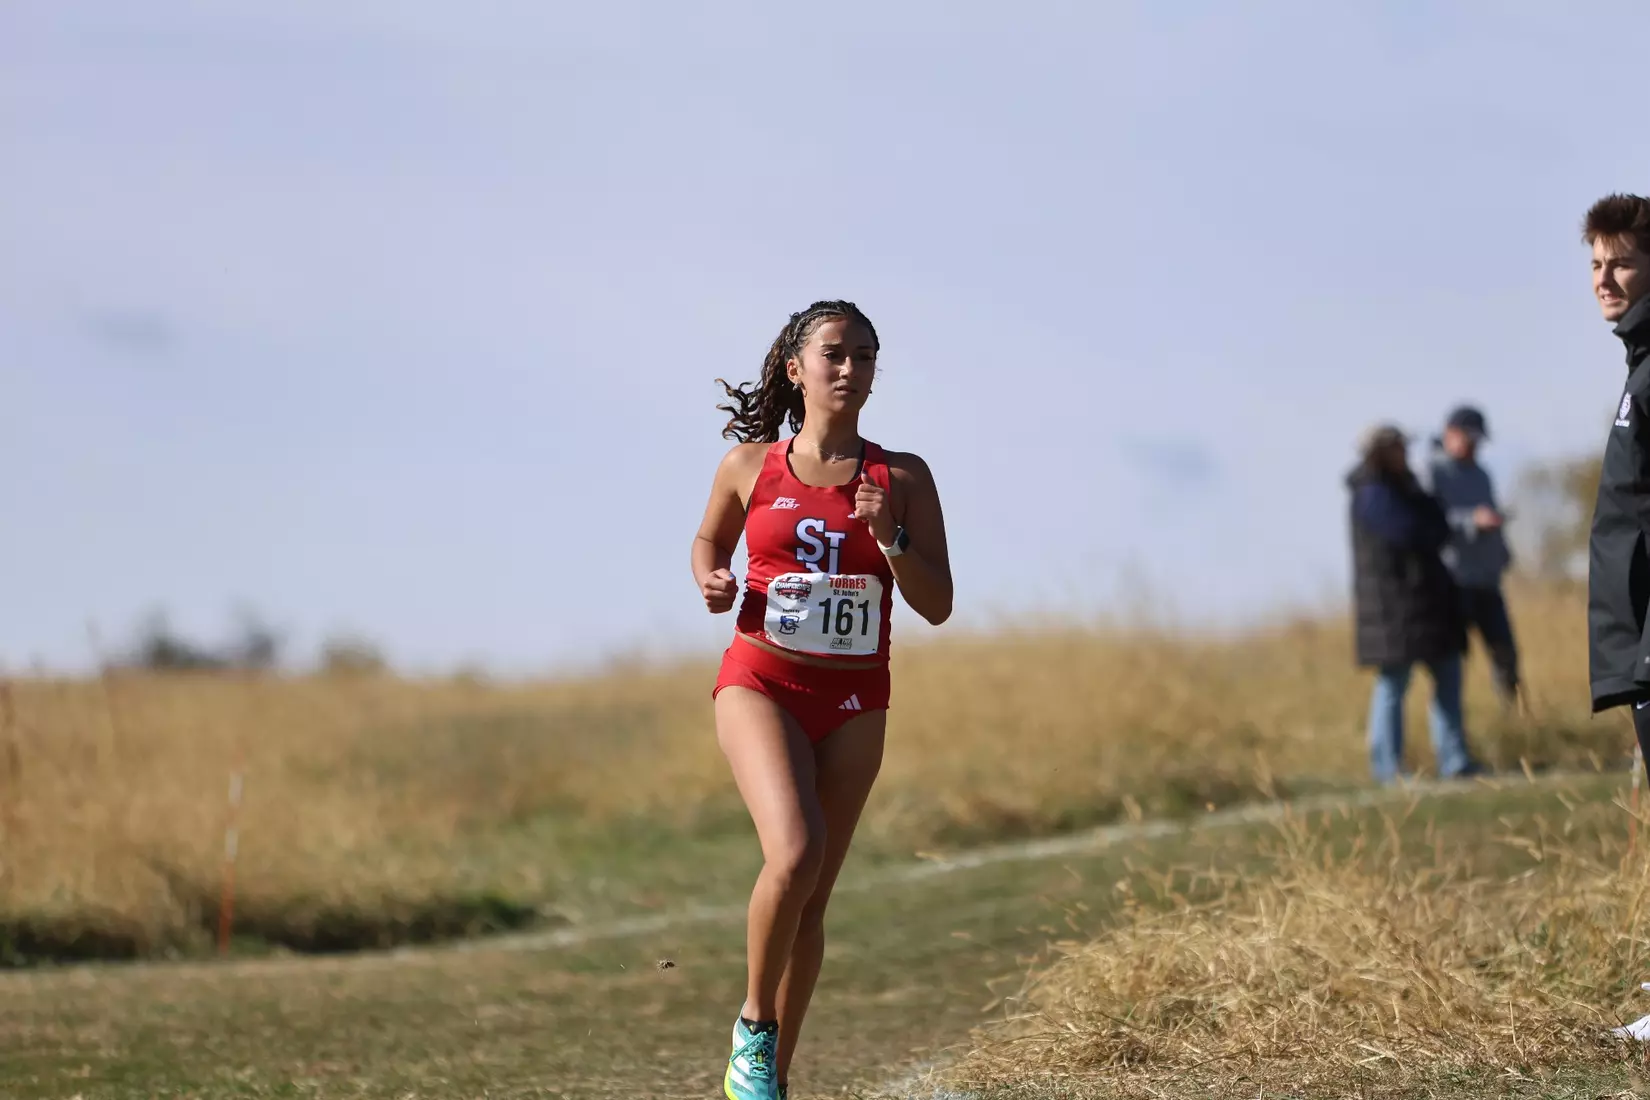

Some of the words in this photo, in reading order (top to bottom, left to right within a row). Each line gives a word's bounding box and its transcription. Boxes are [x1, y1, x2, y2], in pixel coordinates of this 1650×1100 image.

[770, 502, 800, 510] EAST
[829, 577, 867, 590] TORRES
[818, 597, 870, 636] 161
